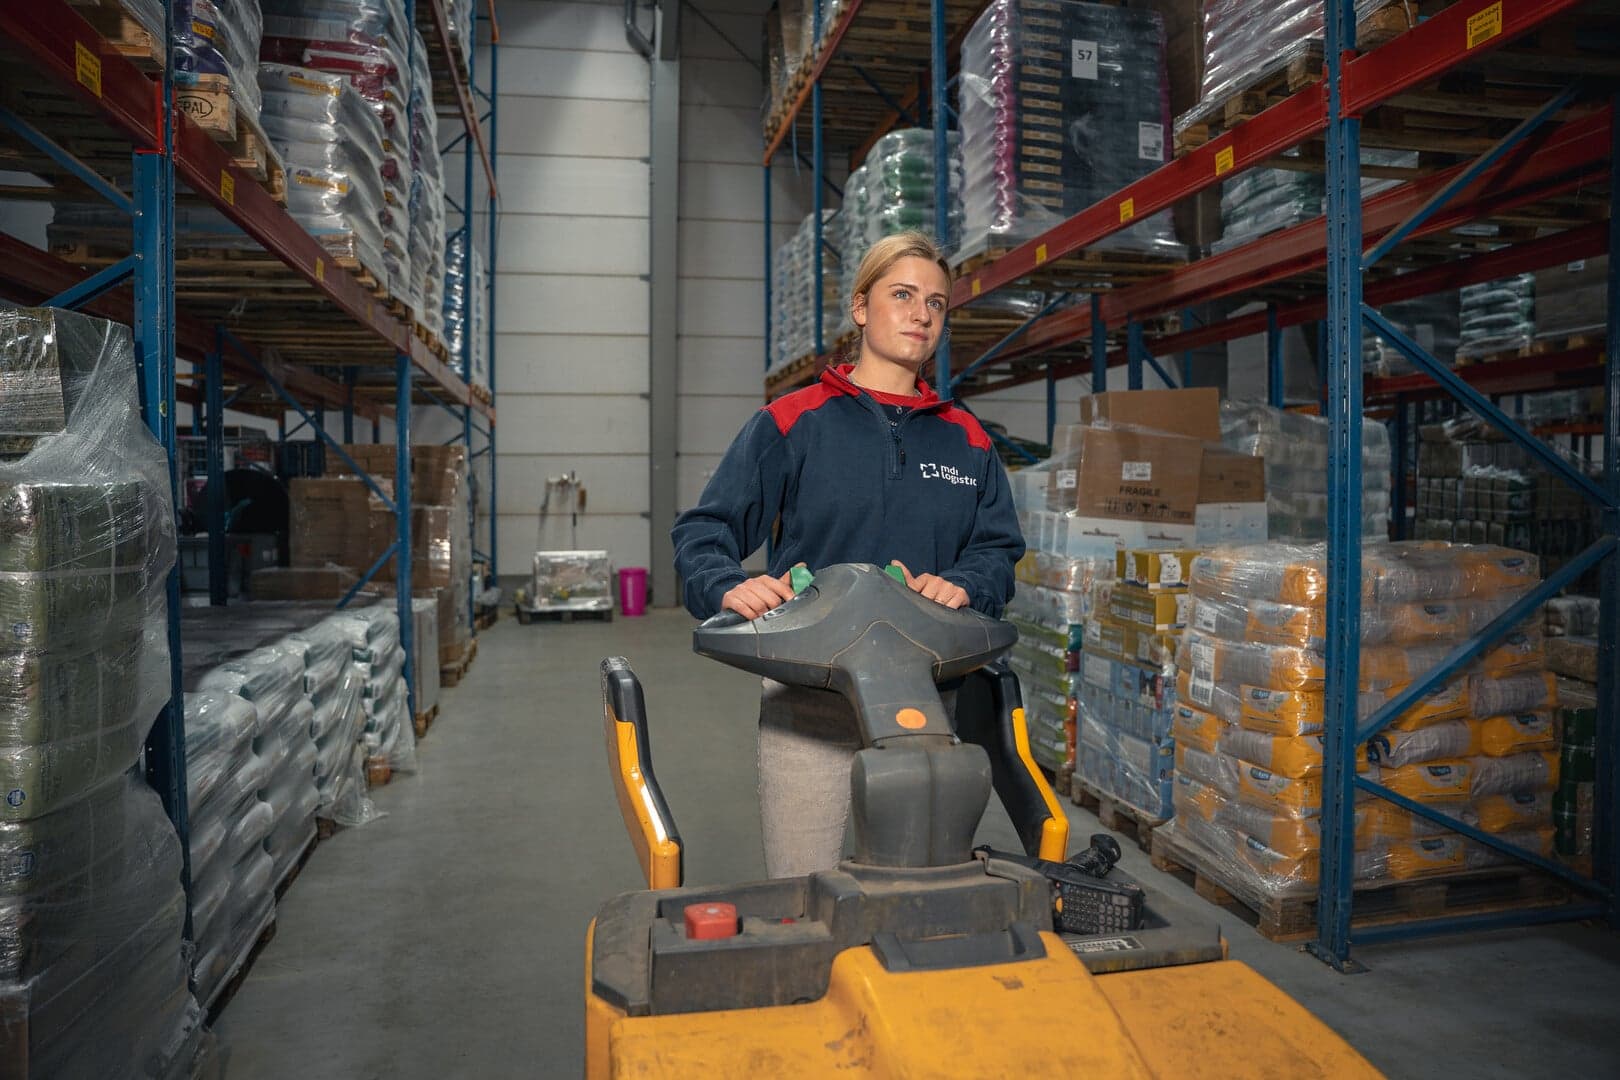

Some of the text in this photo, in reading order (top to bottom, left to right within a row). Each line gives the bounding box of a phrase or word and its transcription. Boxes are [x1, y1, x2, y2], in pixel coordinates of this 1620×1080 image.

[1077, 49, 1093, 61] 57
[940, 465, 959, 476] mdi
[1119, 485, 1161, 497] FRAGILE
